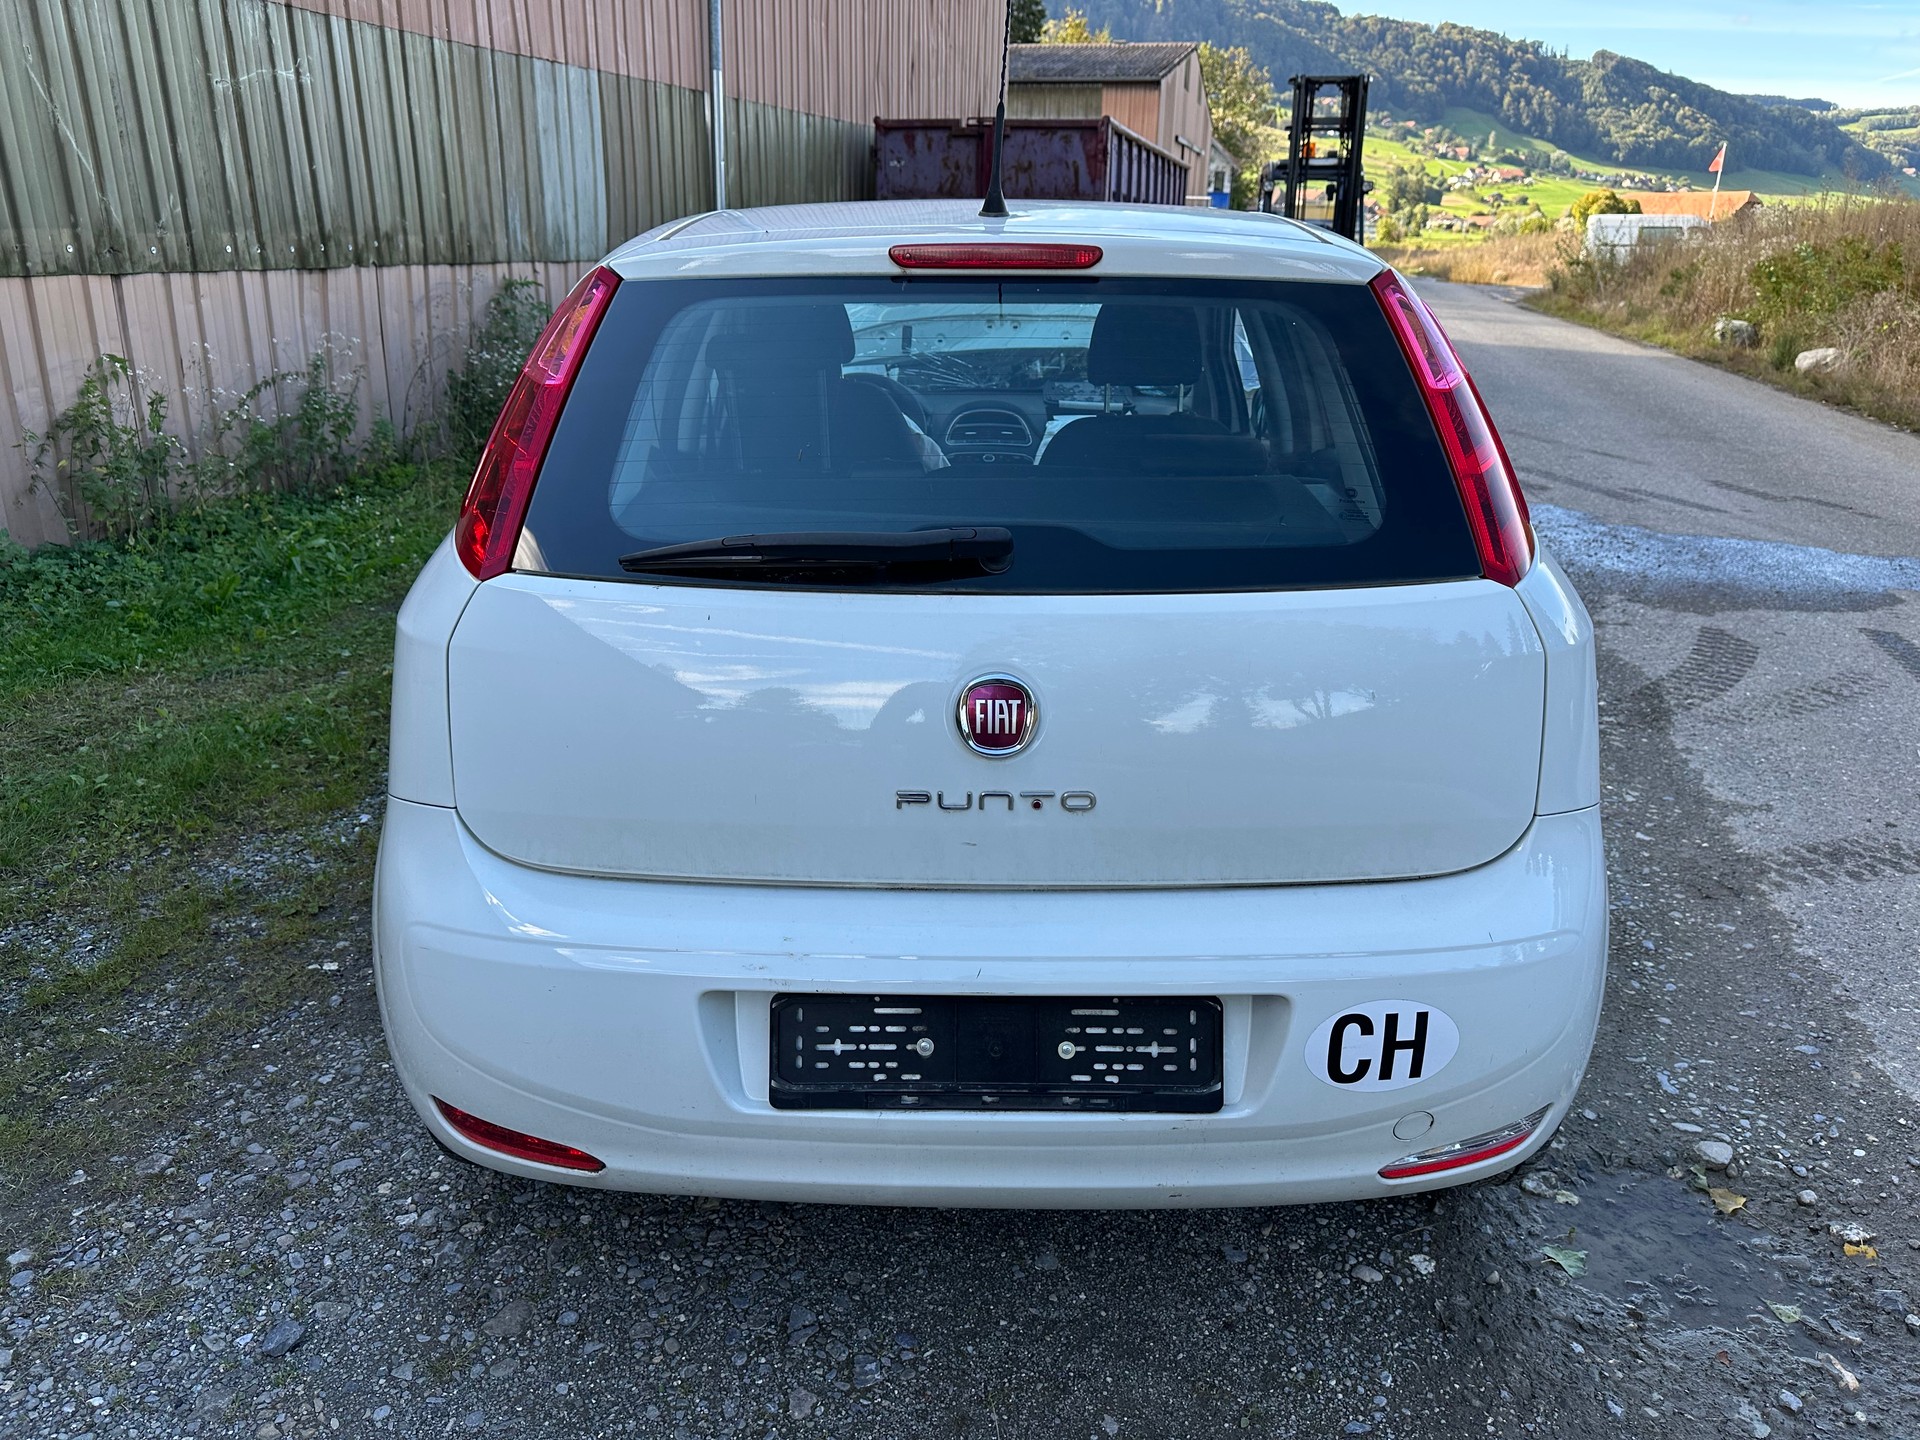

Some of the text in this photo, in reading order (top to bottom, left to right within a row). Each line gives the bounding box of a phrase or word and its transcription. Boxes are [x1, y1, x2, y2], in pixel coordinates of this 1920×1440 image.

[975, 699, 1022, 735] FIAT
[896, 790, 1097, 811] PUNTO
[1327, 1011, 1429, 1084] CH
